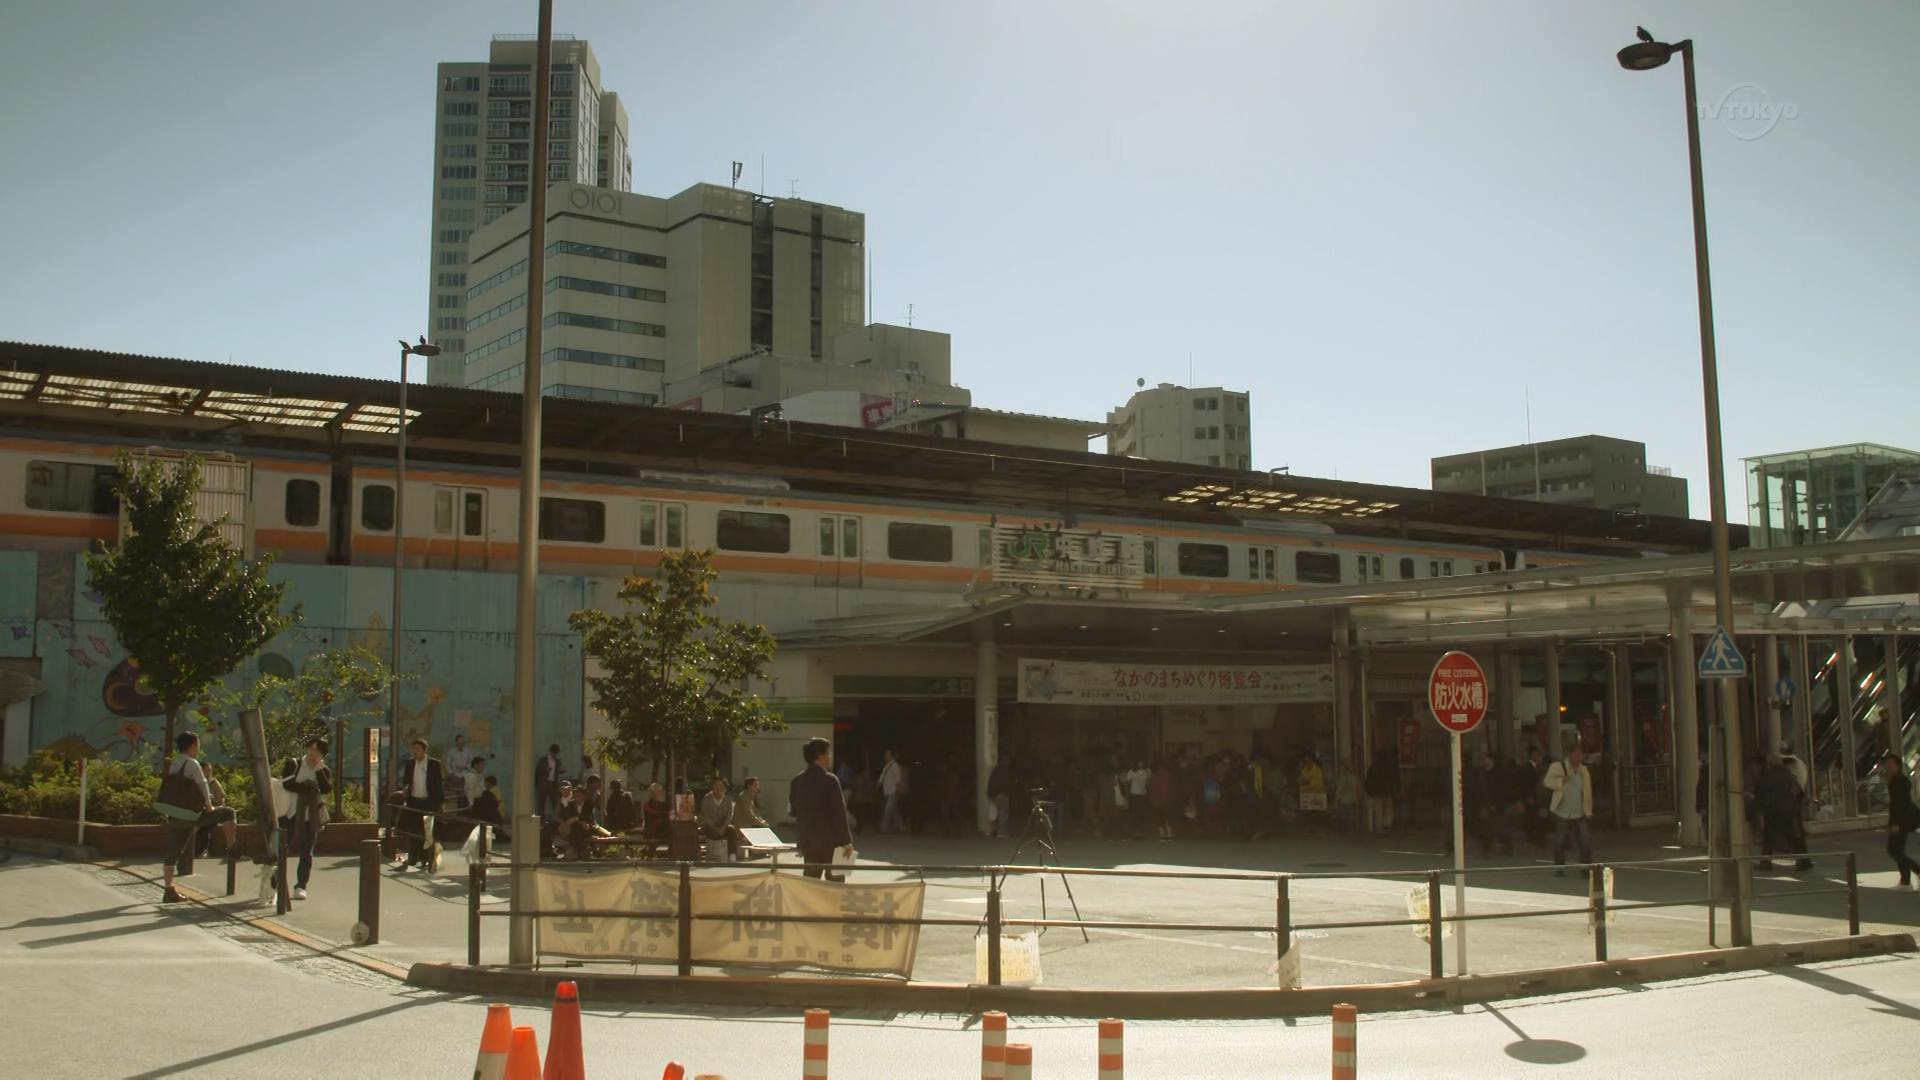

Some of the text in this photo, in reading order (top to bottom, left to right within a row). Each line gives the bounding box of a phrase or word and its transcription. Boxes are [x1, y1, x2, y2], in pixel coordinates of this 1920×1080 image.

[1113, 668, 1262, 690] なかのまちめぐり博覧会
[1434, 681, 1483, 710] 防火水槽
